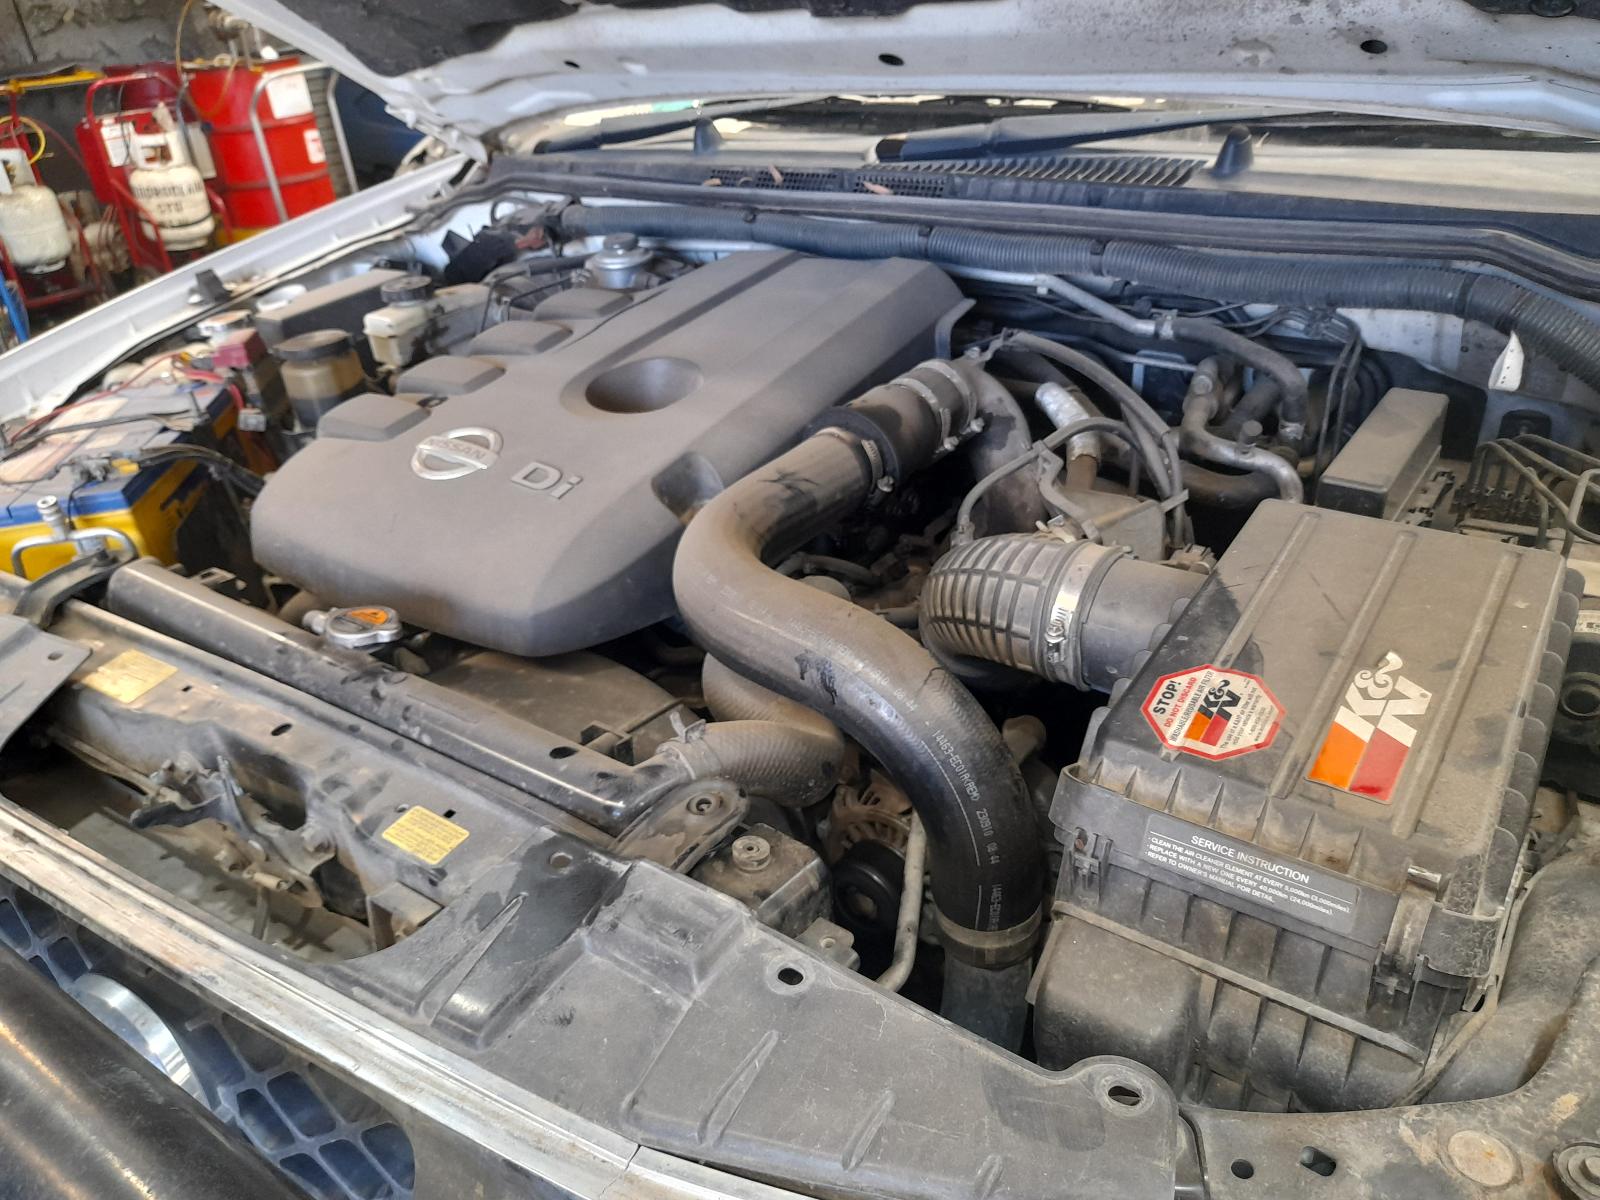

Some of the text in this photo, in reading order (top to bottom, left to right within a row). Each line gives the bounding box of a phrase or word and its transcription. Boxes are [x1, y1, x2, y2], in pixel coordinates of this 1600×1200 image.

[510, 461, 583, 500] Di
[1152, 680, 1182, 715] STOP!
[1177, 676, 1198, 703] DISCARD
[1333, 650, 1433, 748] K&N
[1147, 851, 1168, 864] REFER
[1168, 857, 1177, 866] TO
[1208, 873, 1235, 888] MANUAL
[1236, 884, 1252, 894] FOR
[1149, 843, 1178, 859] REPLACE
[1178, 854, 1196, 866] WITH
[1202, 863, 1220, 875] NEW
[1219, 870, 1236, 880] ONE
[1235, 875, 1259, 889] EVERY
[1151, 837, 1172, 850] CLEAN
[1172, 844, 1184, 854] THE
[1184, 849, 1196, 858] AIR
[1195, 853, 1224, 868] CLEANER
[1224, 863, 1255, 879] ELEMENT
[1262, 876, 1284, 889] EVERY
[1190, 835, 1310, 884] SERVICE INSTRUCTION
